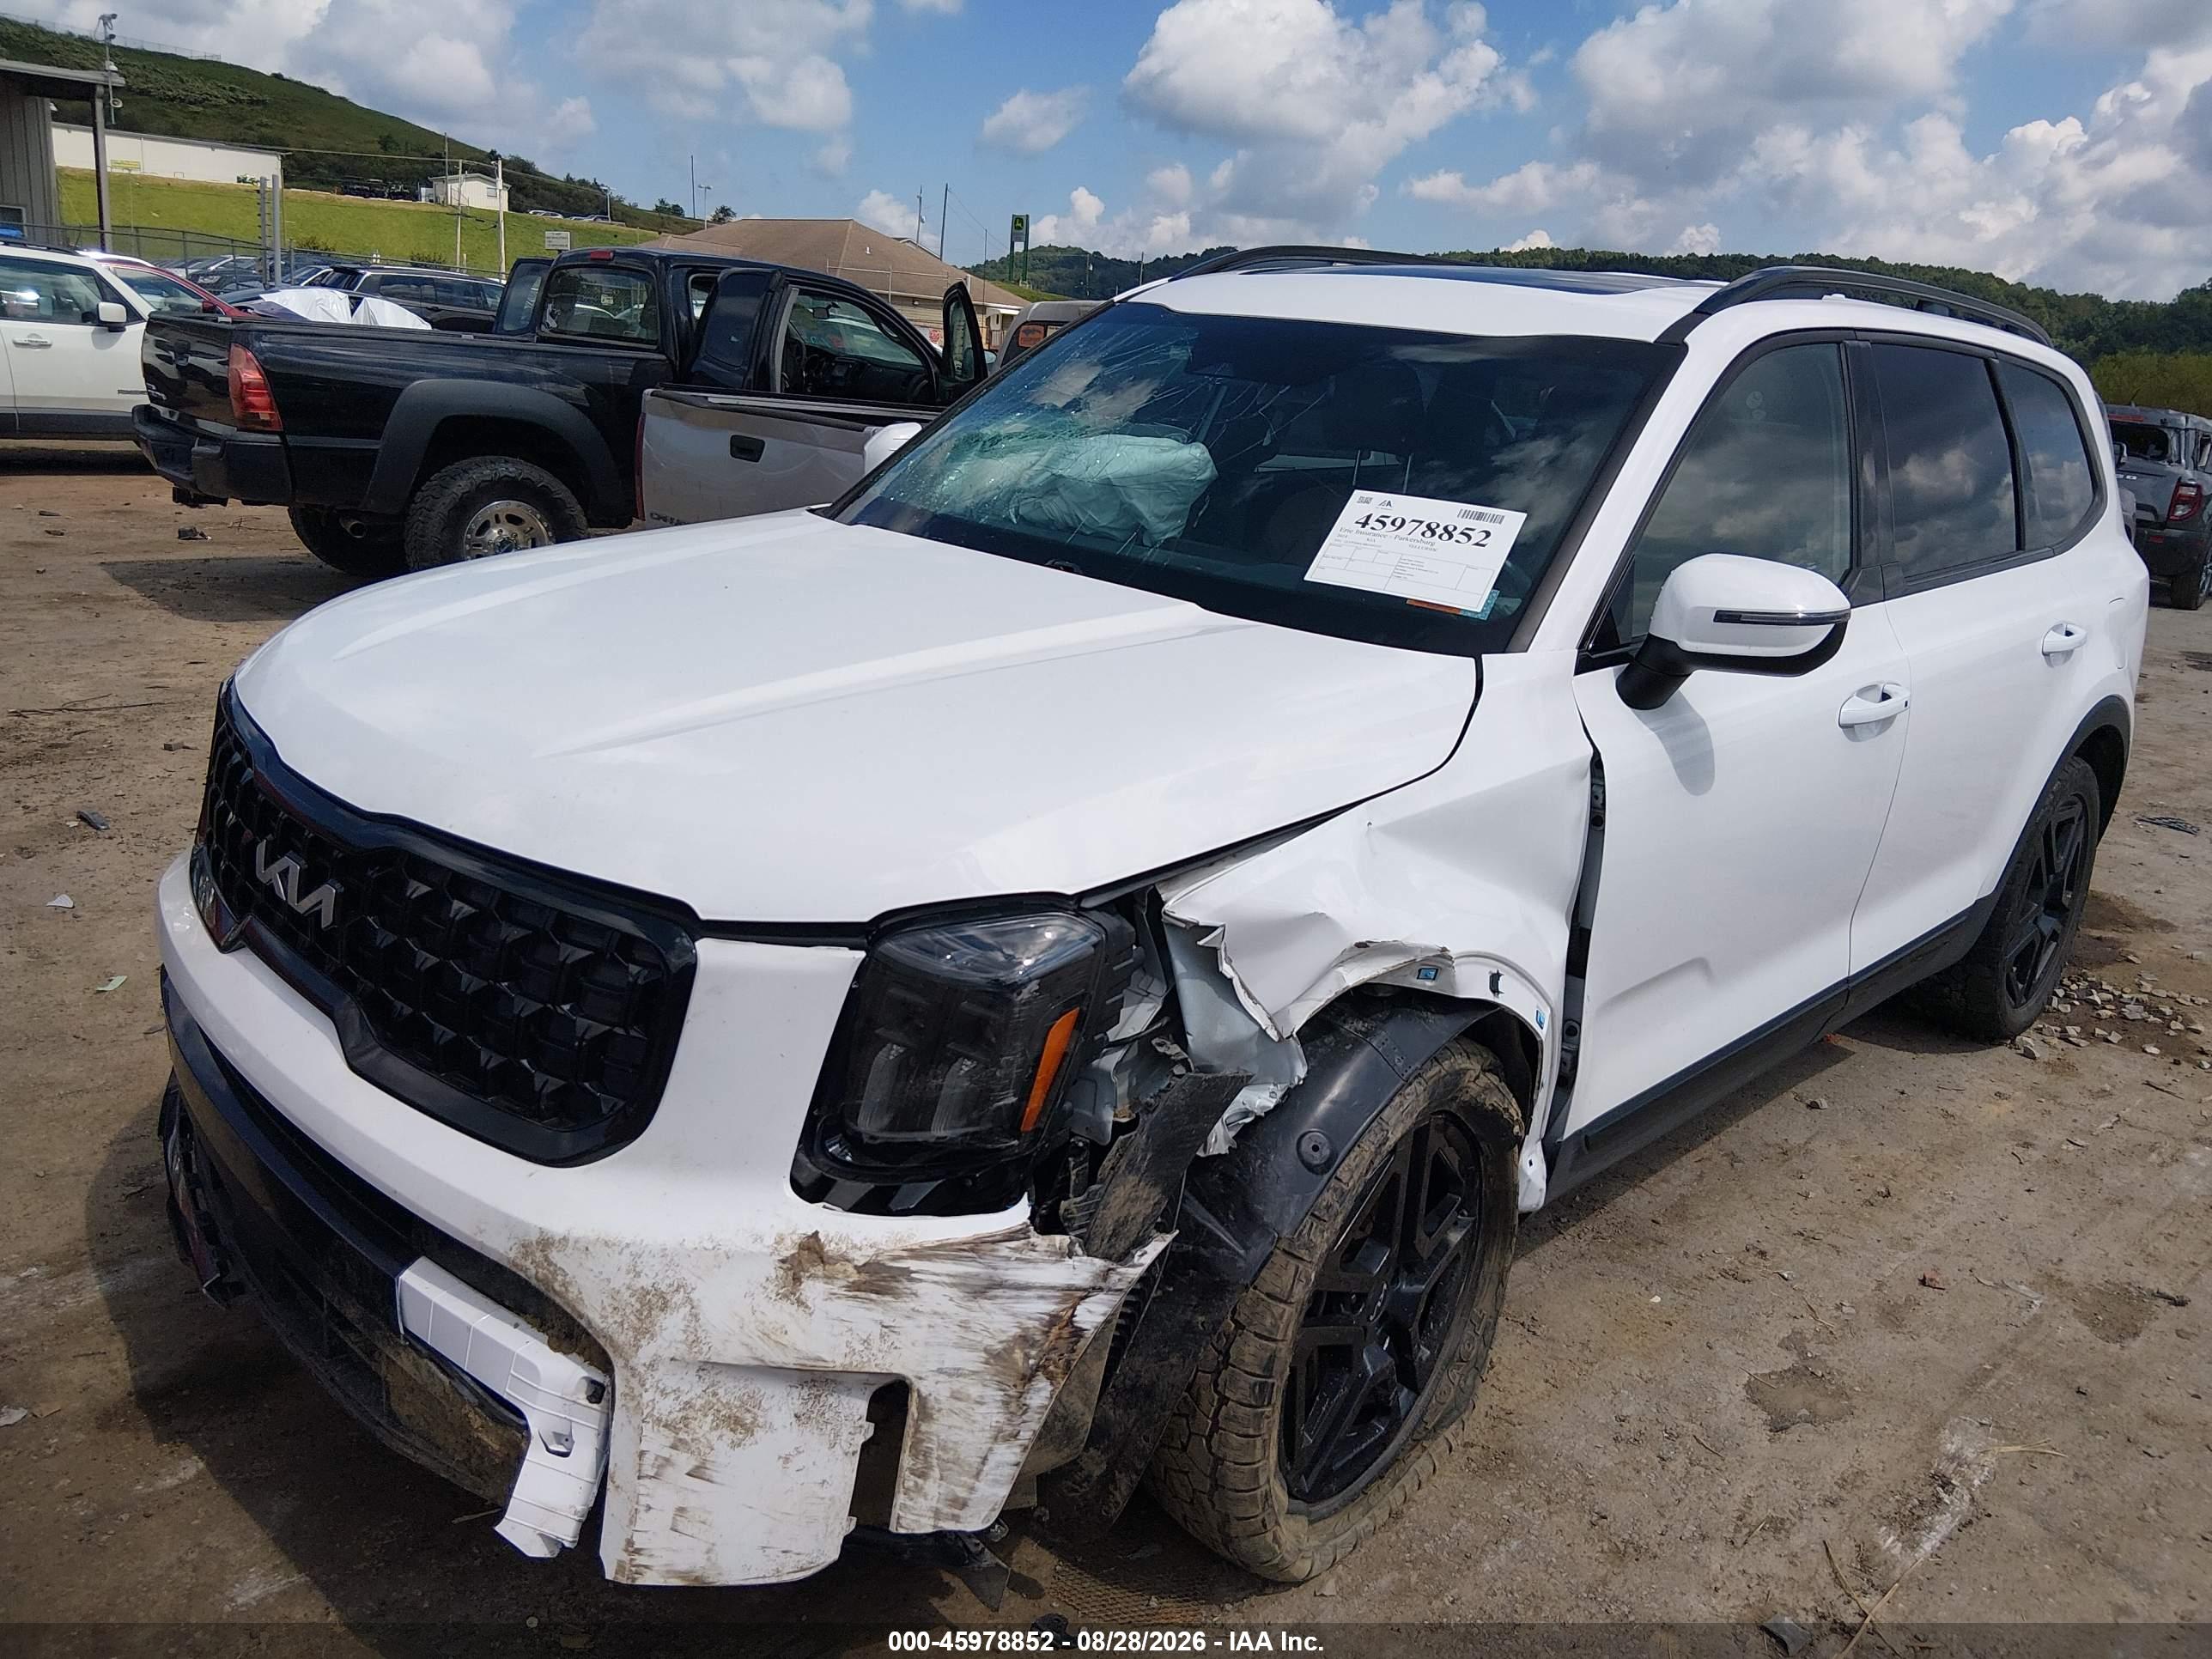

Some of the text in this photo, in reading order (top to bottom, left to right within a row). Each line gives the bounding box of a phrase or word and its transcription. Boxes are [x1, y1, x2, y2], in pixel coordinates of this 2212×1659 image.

[1354, 513, 1492, 548] 45978852
[1354, 529, 1388, 539] Insurance
[1394, 534, 1436, 547] Parkersburg
